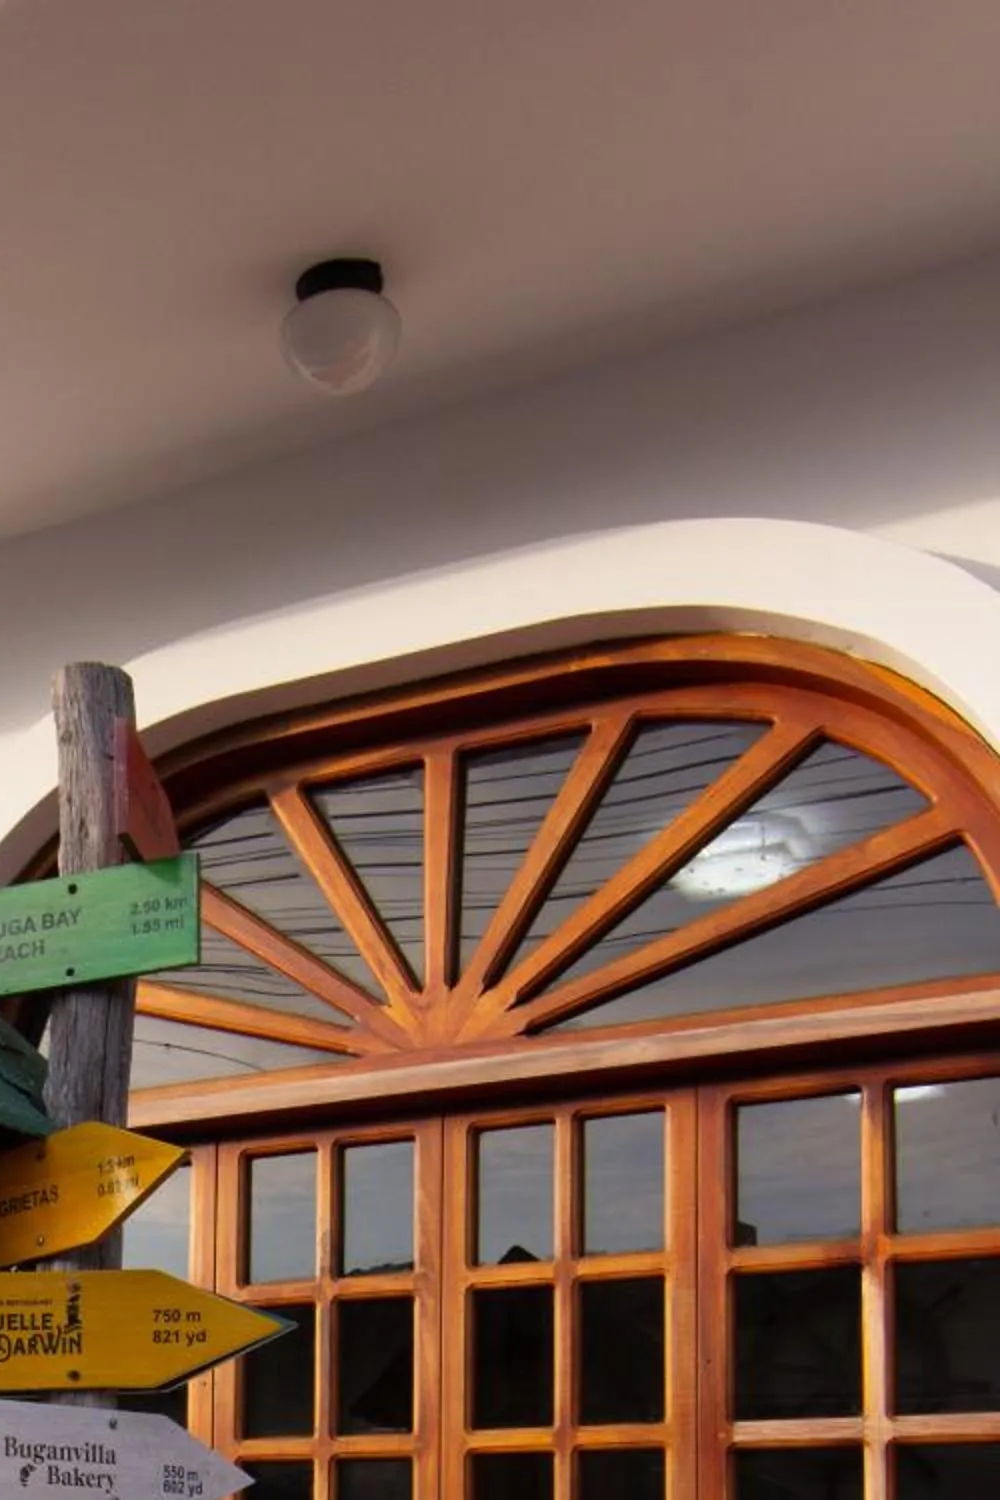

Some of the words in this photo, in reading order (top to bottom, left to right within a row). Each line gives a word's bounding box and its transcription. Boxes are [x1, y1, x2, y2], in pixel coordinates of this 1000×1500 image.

[130, 899, 161, 916] 2.50
[163, 895, 188, 912] km
[41, 907, 83, 931] BAY
[131, 919, 162, 937] 1.55
[165, 914, 184, 931] mi
[152, 1309, 181, 1323] 750
[185, 1311, 201, 1323] m
[152, 1330, 181, 1344] 821
[185, 1329, 207, 1347] yd
[3, 1436, 117, 1466] Buganvilla
[47, 1465, 116, 1494] Bakery
[187, 1469, 199, 1481] m
[187, 1481, 203, 1498] yd
